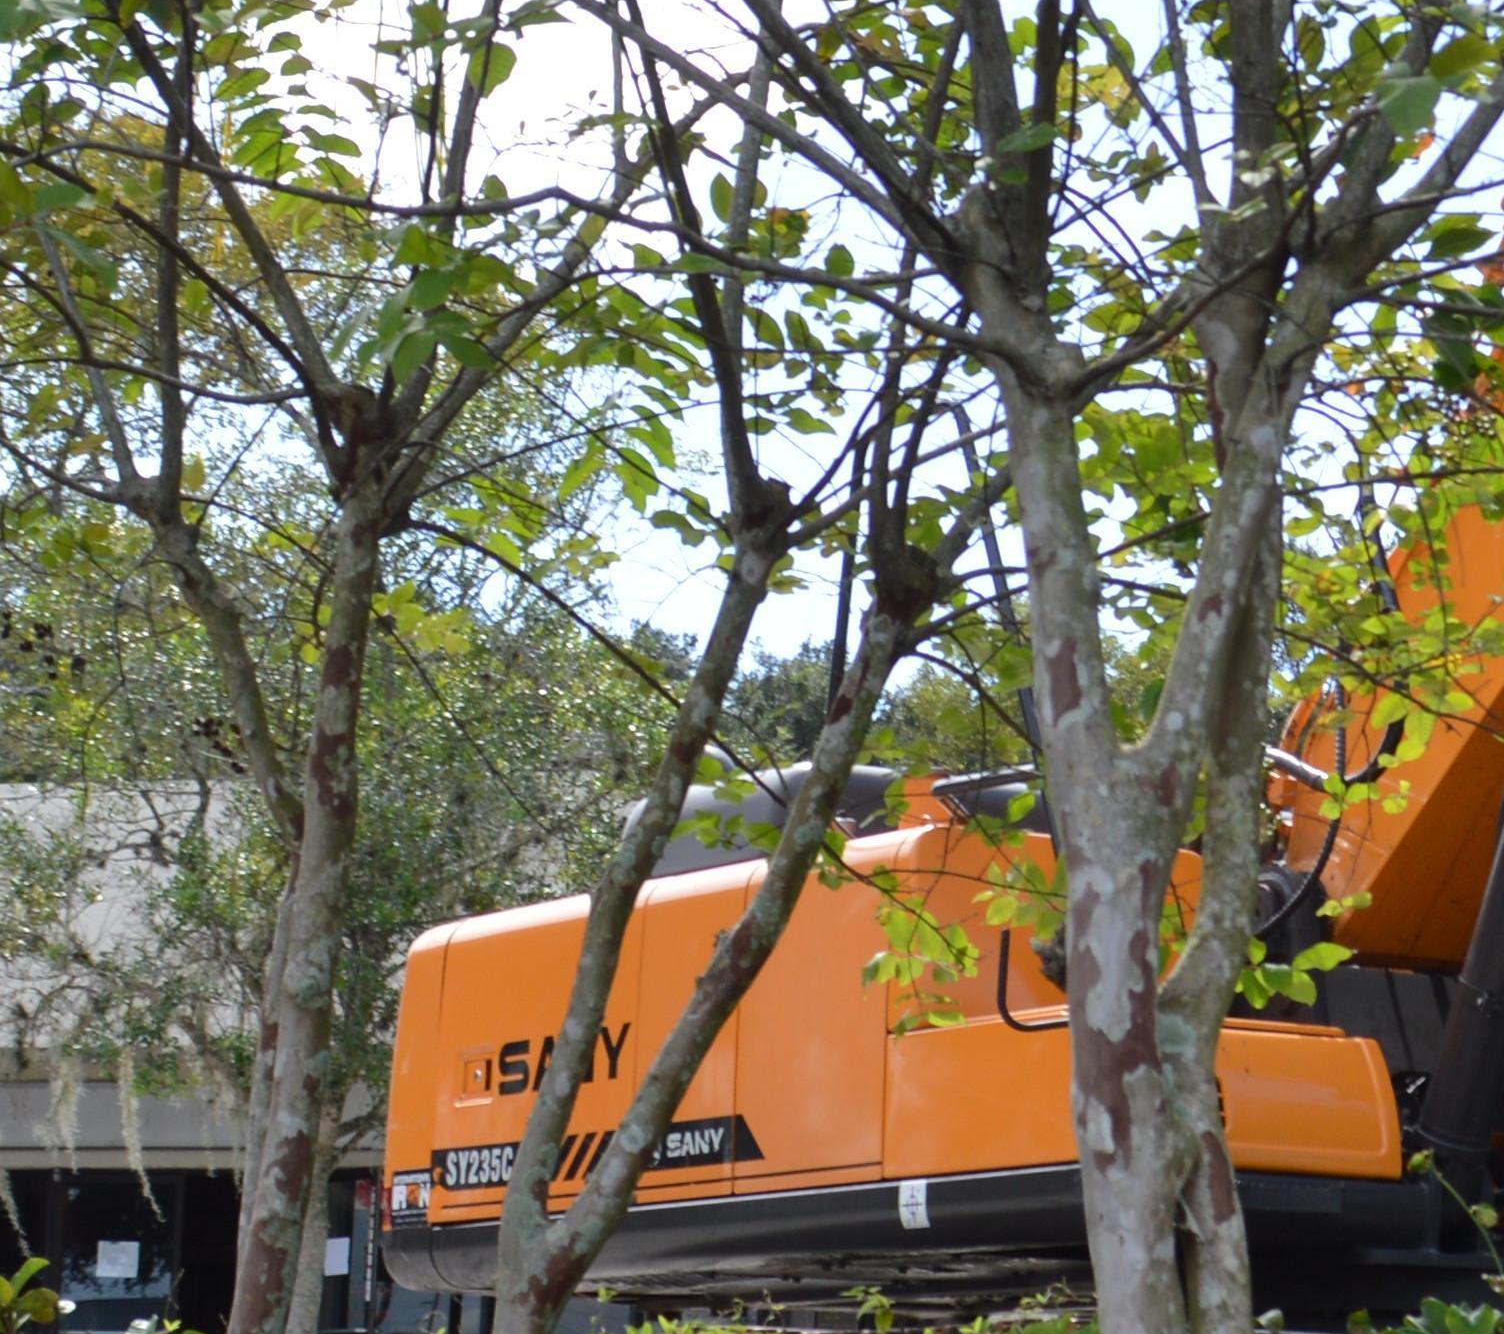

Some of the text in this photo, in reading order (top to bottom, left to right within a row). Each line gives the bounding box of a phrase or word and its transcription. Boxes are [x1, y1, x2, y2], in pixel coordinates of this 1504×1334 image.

[498, 1022, 632, 1096] SAY
[665, 1127, 725, 1158] SANY
[446, 1146, 514, 1186] SY235C
